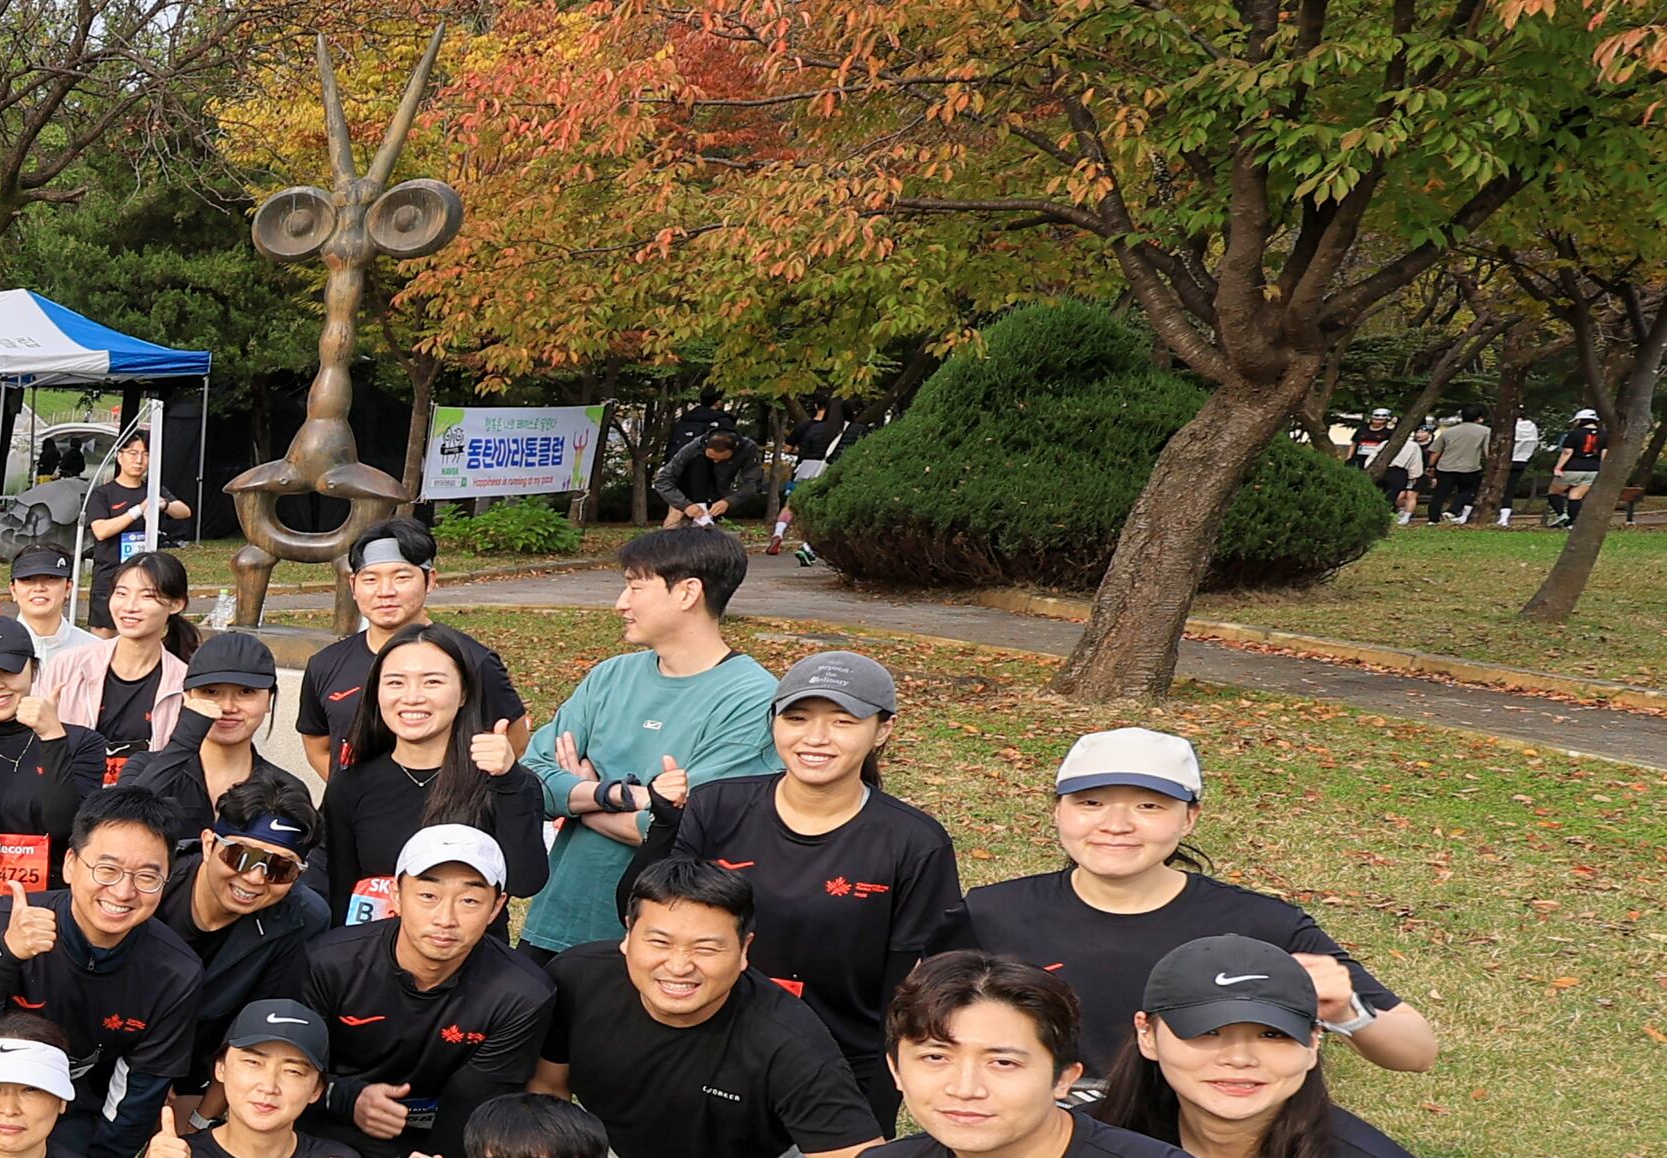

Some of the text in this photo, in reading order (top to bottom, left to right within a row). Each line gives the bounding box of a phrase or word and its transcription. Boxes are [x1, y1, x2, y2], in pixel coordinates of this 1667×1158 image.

[467, 436, 565, 469] 동탄마라톤클럽
[124, 544, 133, 554] D
[369, 878, 392, 894] SK
[356, 901, 373, 923] B
